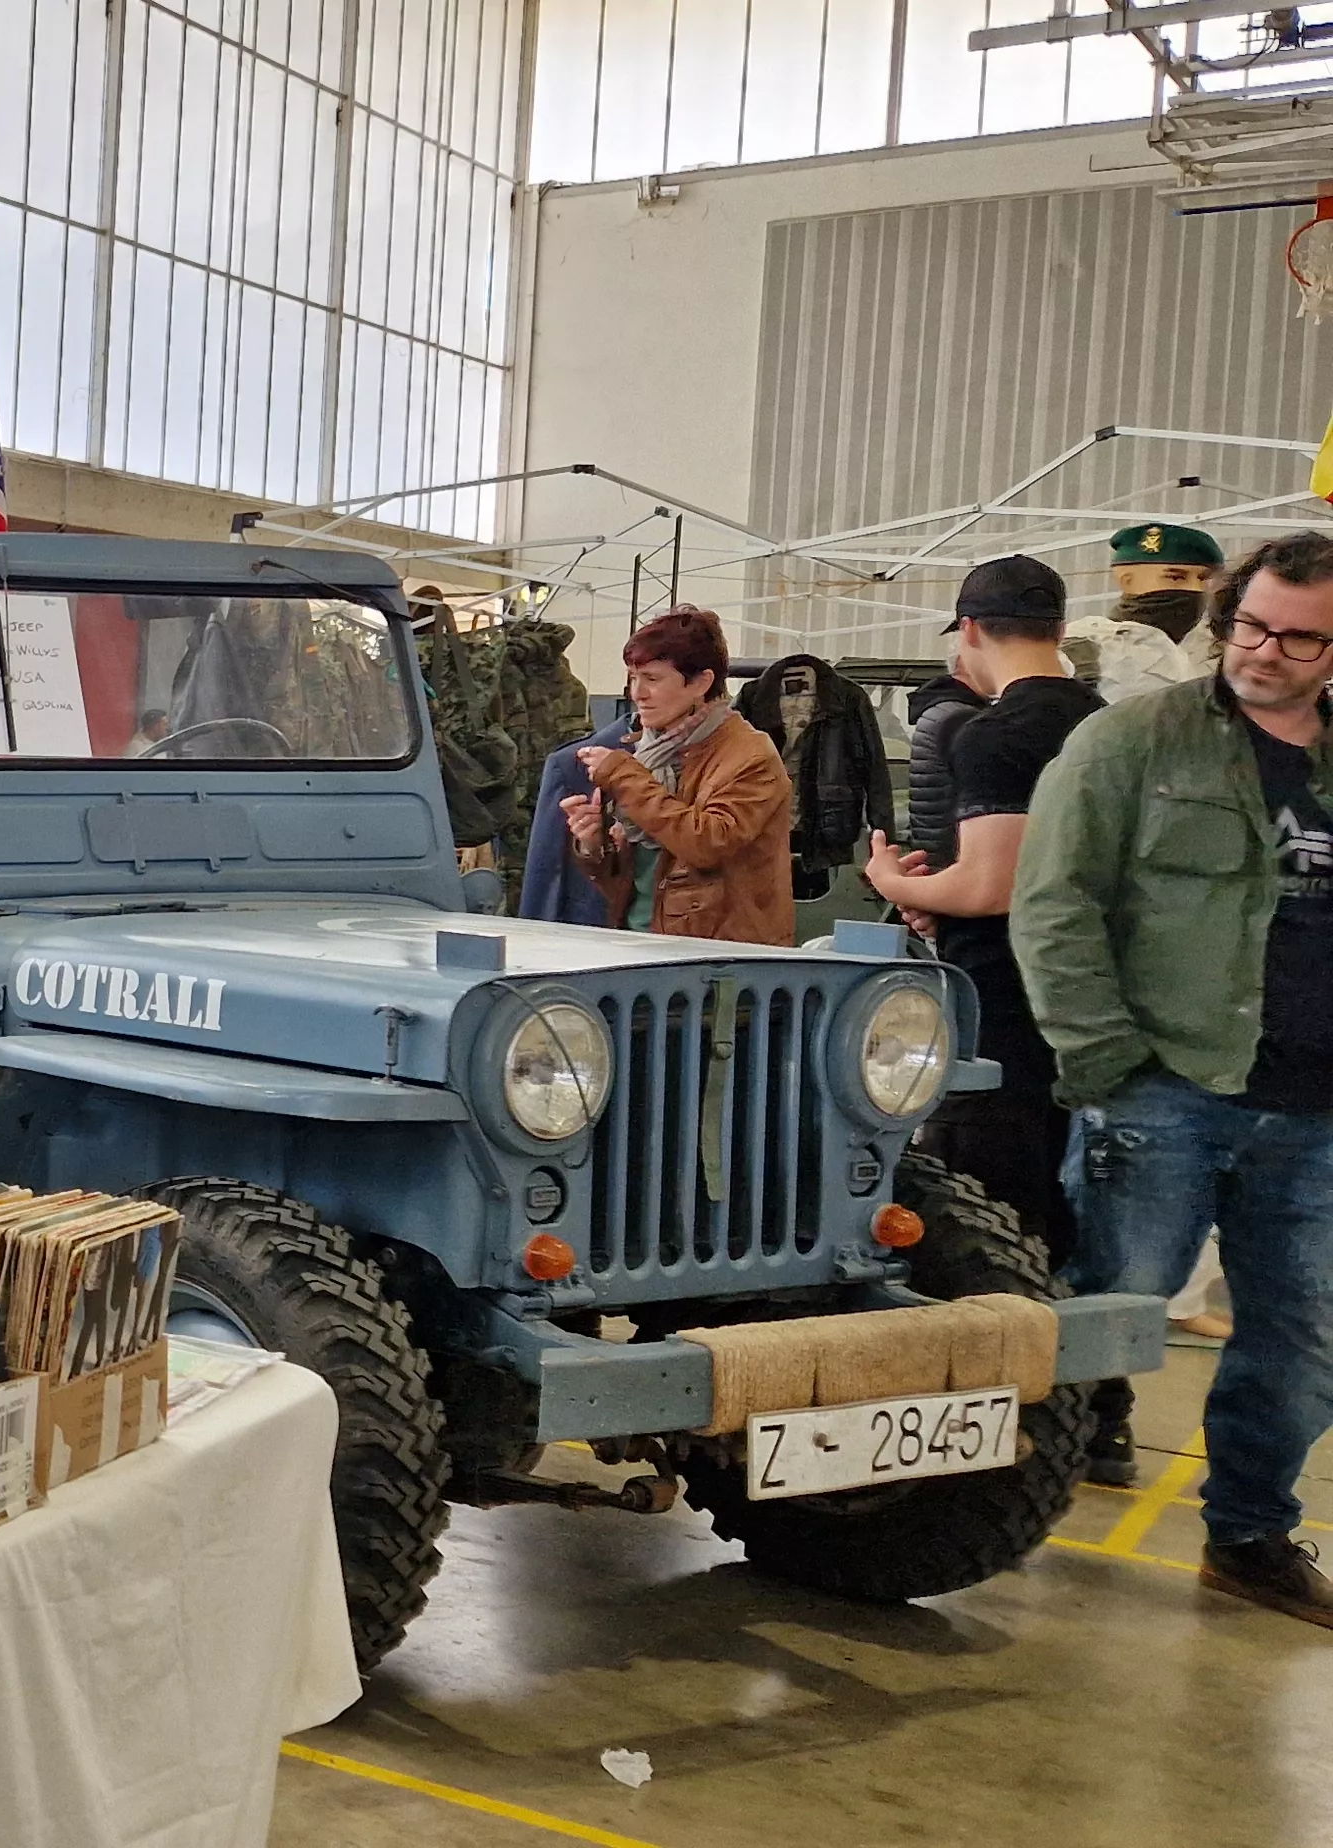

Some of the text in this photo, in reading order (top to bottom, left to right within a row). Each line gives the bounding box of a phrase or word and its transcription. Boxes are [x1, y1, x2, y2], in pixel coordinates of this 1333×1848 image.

[9, 621, 44, 632] JEEP
[11, 671, 45, 684] USA
[22, 699, 74, 711] GASOLINA
[15, 957, 227, 1031] COTRALI
[759, 1424, 786, 1489] Z
[871, 1396, 1014, 1473] 28457
